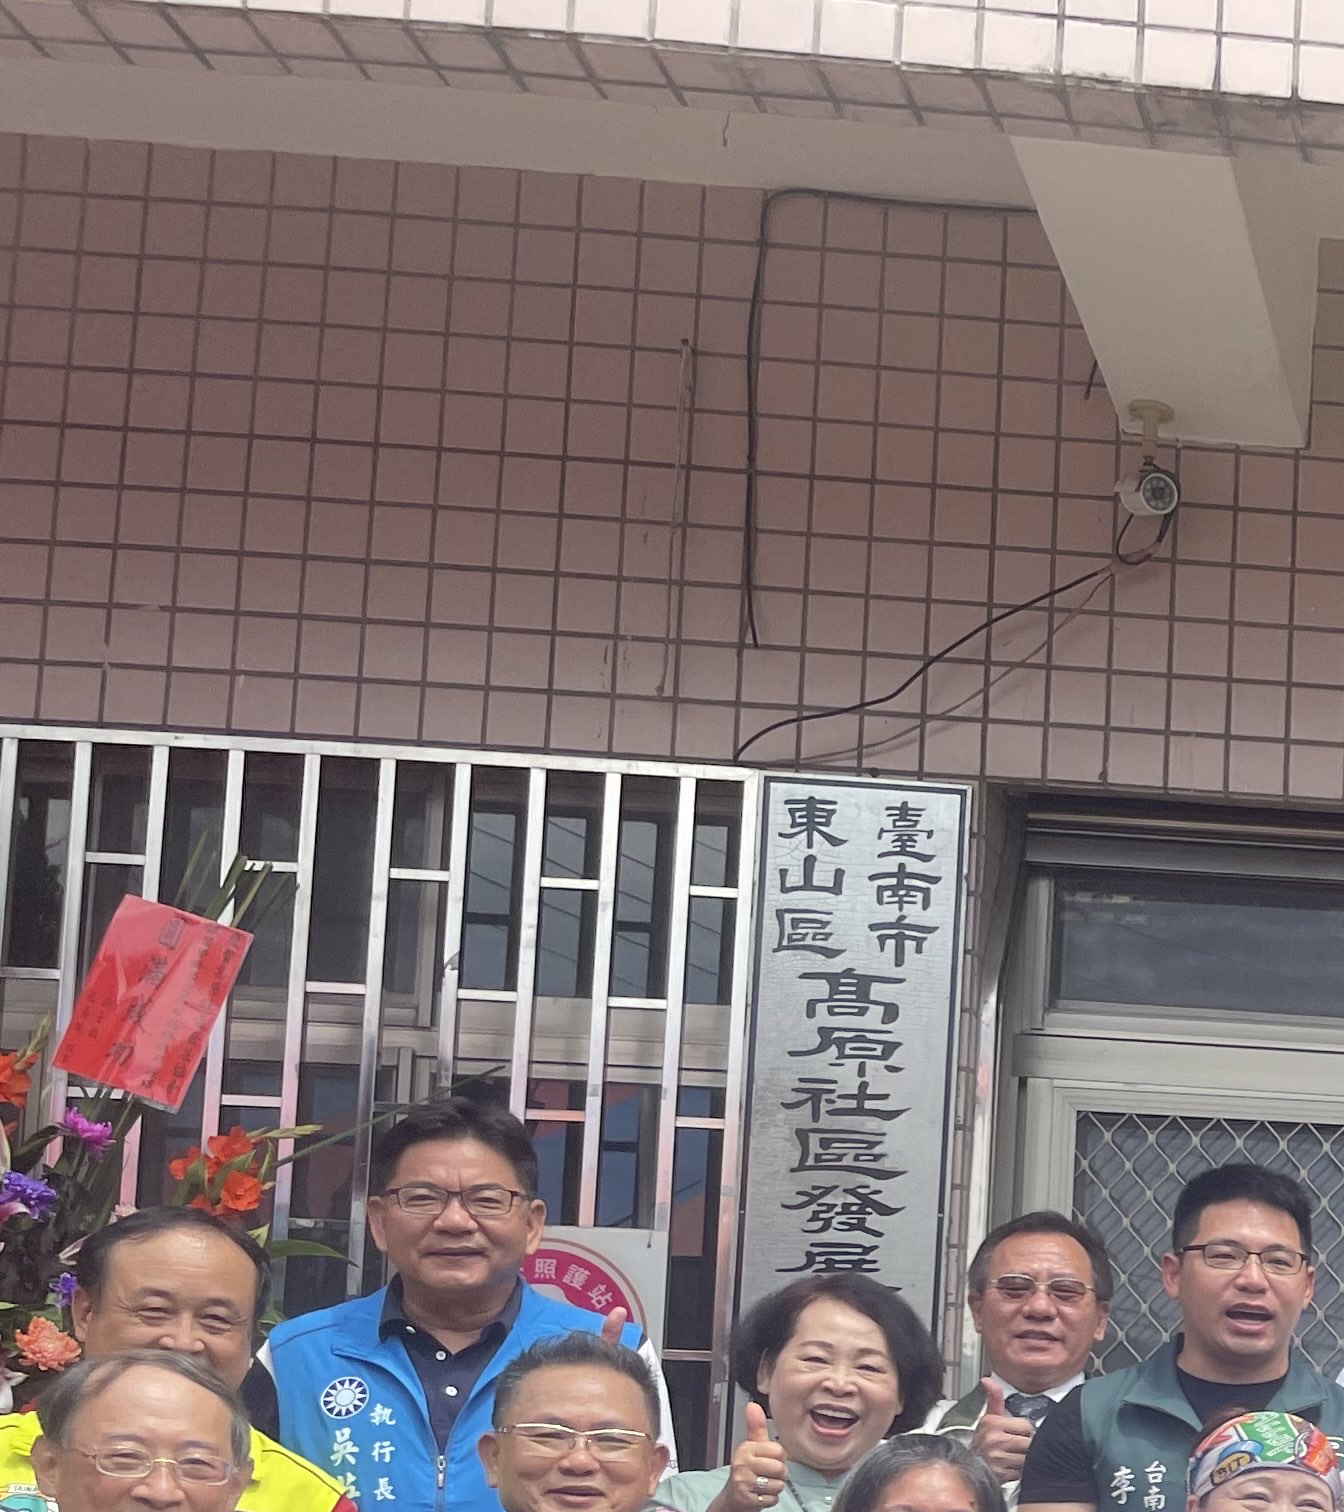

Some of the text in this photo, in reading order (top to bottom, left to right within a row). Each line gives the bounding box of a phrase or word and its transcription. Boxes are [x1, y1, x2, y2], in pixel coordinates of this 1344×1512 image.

[772, 795, 849, 959] 東山區
[868, 800, 942, 968] 臺南市
[519, 1257, 613, 1309] 照護站
[369, 1403, 397, 1501] 執行長
